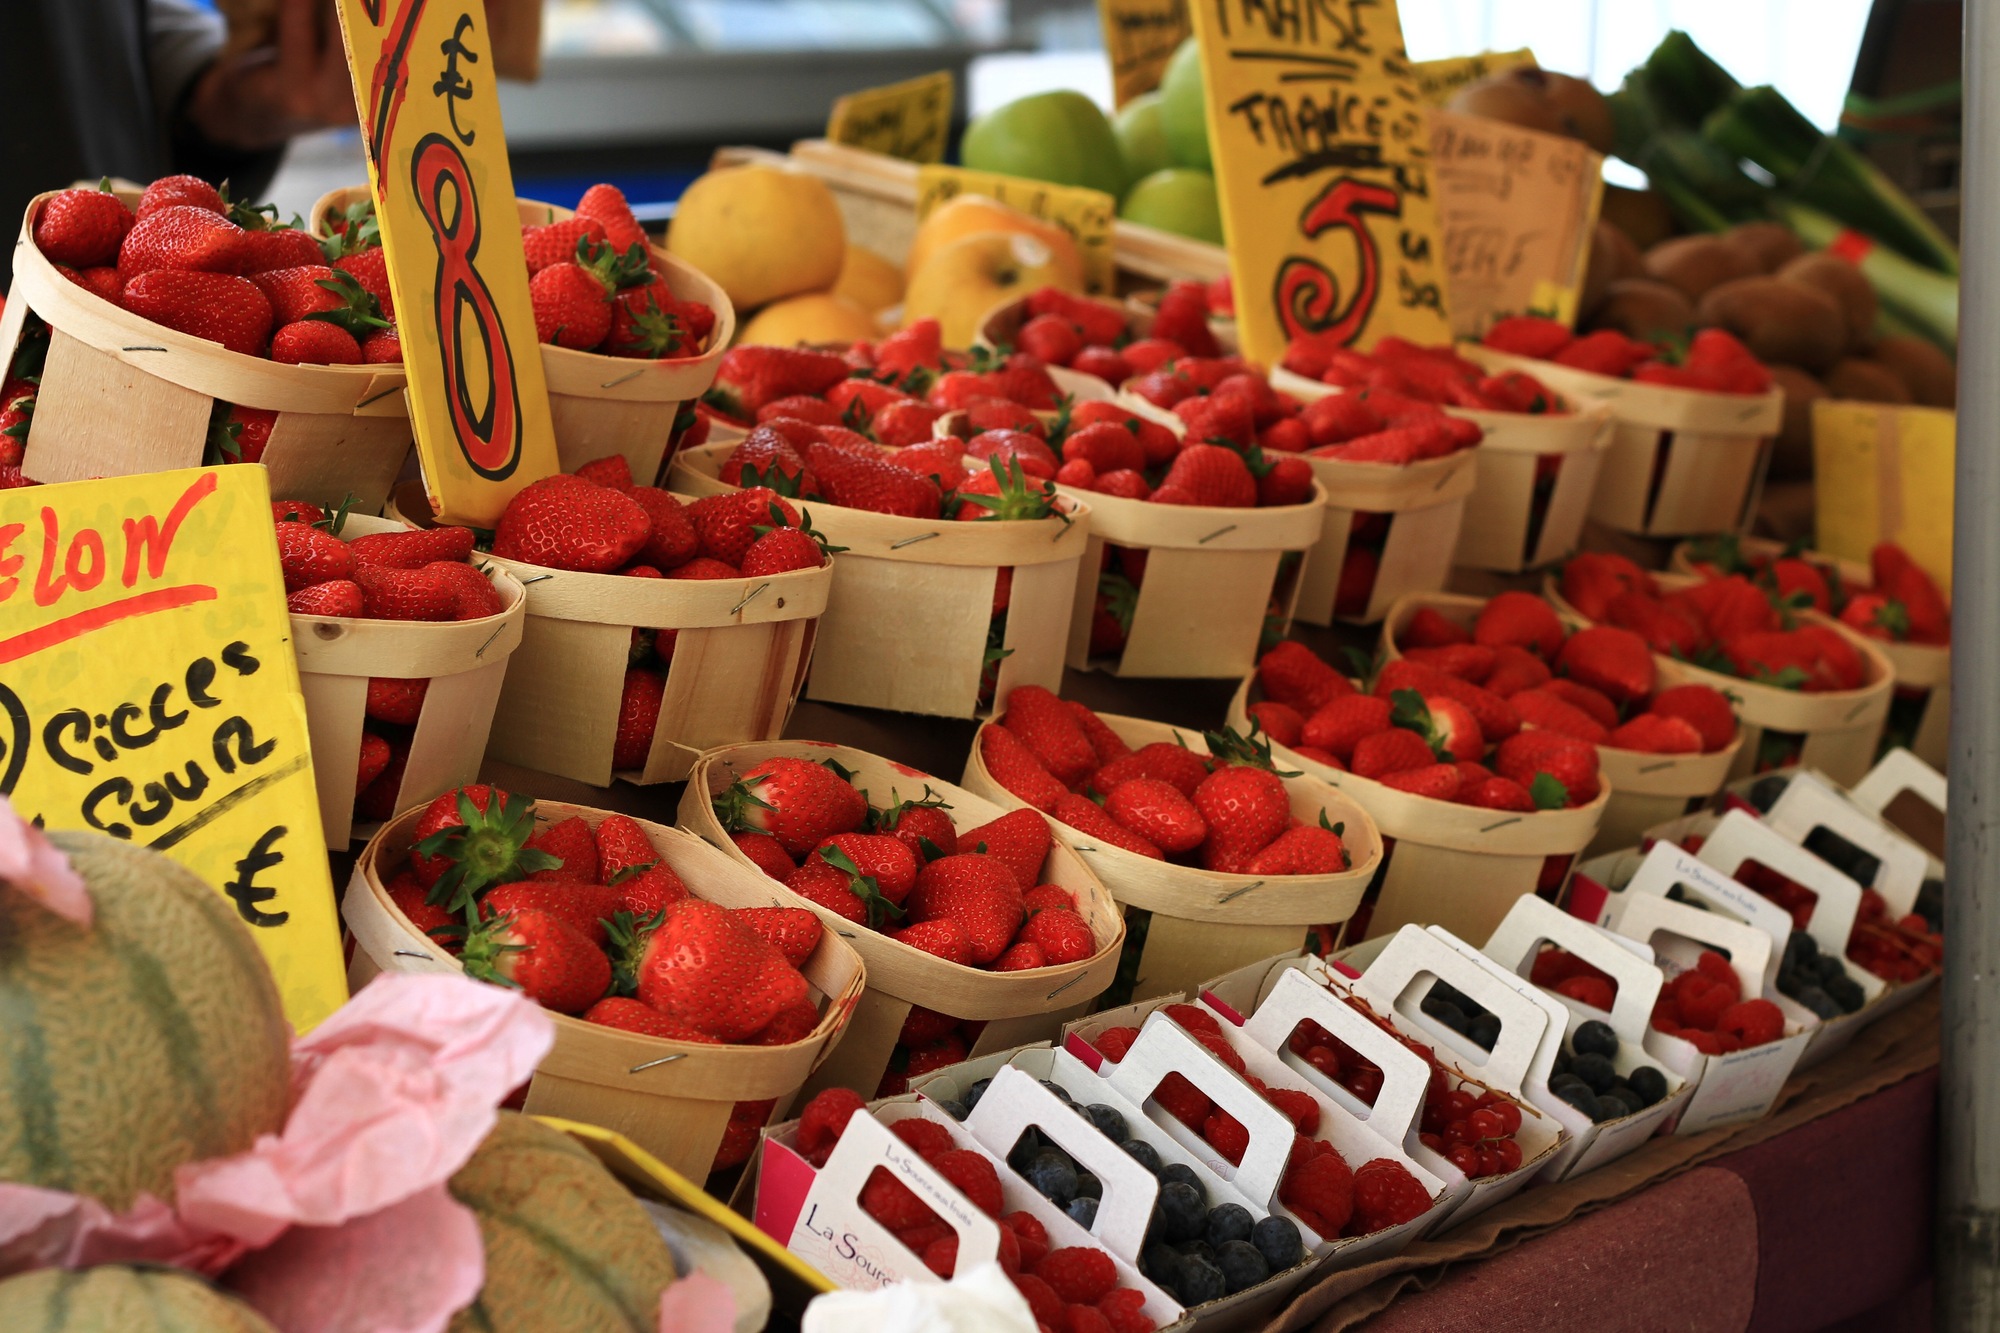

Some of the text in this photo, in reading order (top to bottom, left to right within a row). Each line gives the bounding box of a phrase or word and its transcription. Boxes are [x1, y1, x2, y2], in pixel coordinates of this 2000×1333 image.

[432, 13, 479, 146] €
[1229, 88, 1389, 148] FRANCE
[410, 132, 523, 482] 8
[1272, 175, 1402, 347] 5
[224, 825, 290, 928] €
[885, 1144, 900, 1164] La
[899, 1158, 933, 1193] Source
[805, 1203, 834, 1241] La
